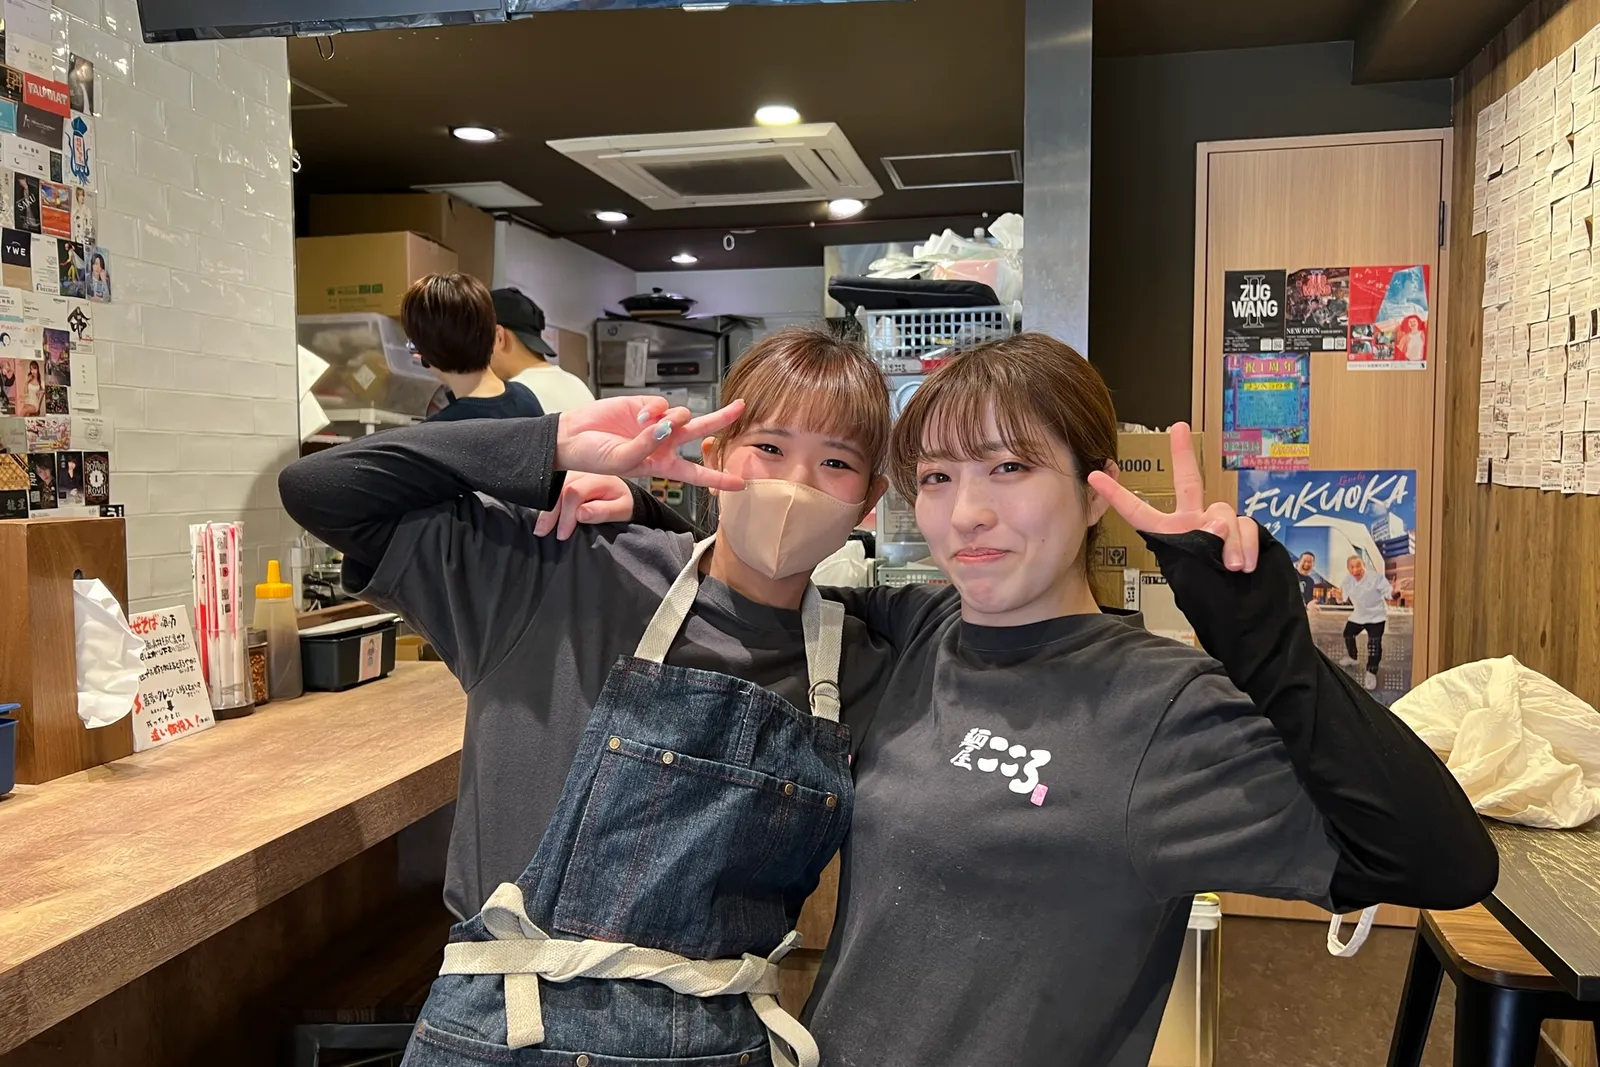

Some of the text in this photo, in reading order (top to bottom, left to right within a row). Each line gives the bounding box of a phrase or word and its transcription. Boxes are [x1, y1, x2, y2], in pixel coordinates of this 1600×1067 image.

[6, 245, 26, 256] YWE
[1240, 284, 1271, 302] ZUG
[1232, 300, 1278, 318] WANG
[1303, 327, 1320, 335] OPEN
[1157, 459, 1165, 472] L
[1244, 474, 1409, 521] FUKUOKA
[129, 613, 160, 634] ぜそば
[977, 736, 1051, 794] こころ
